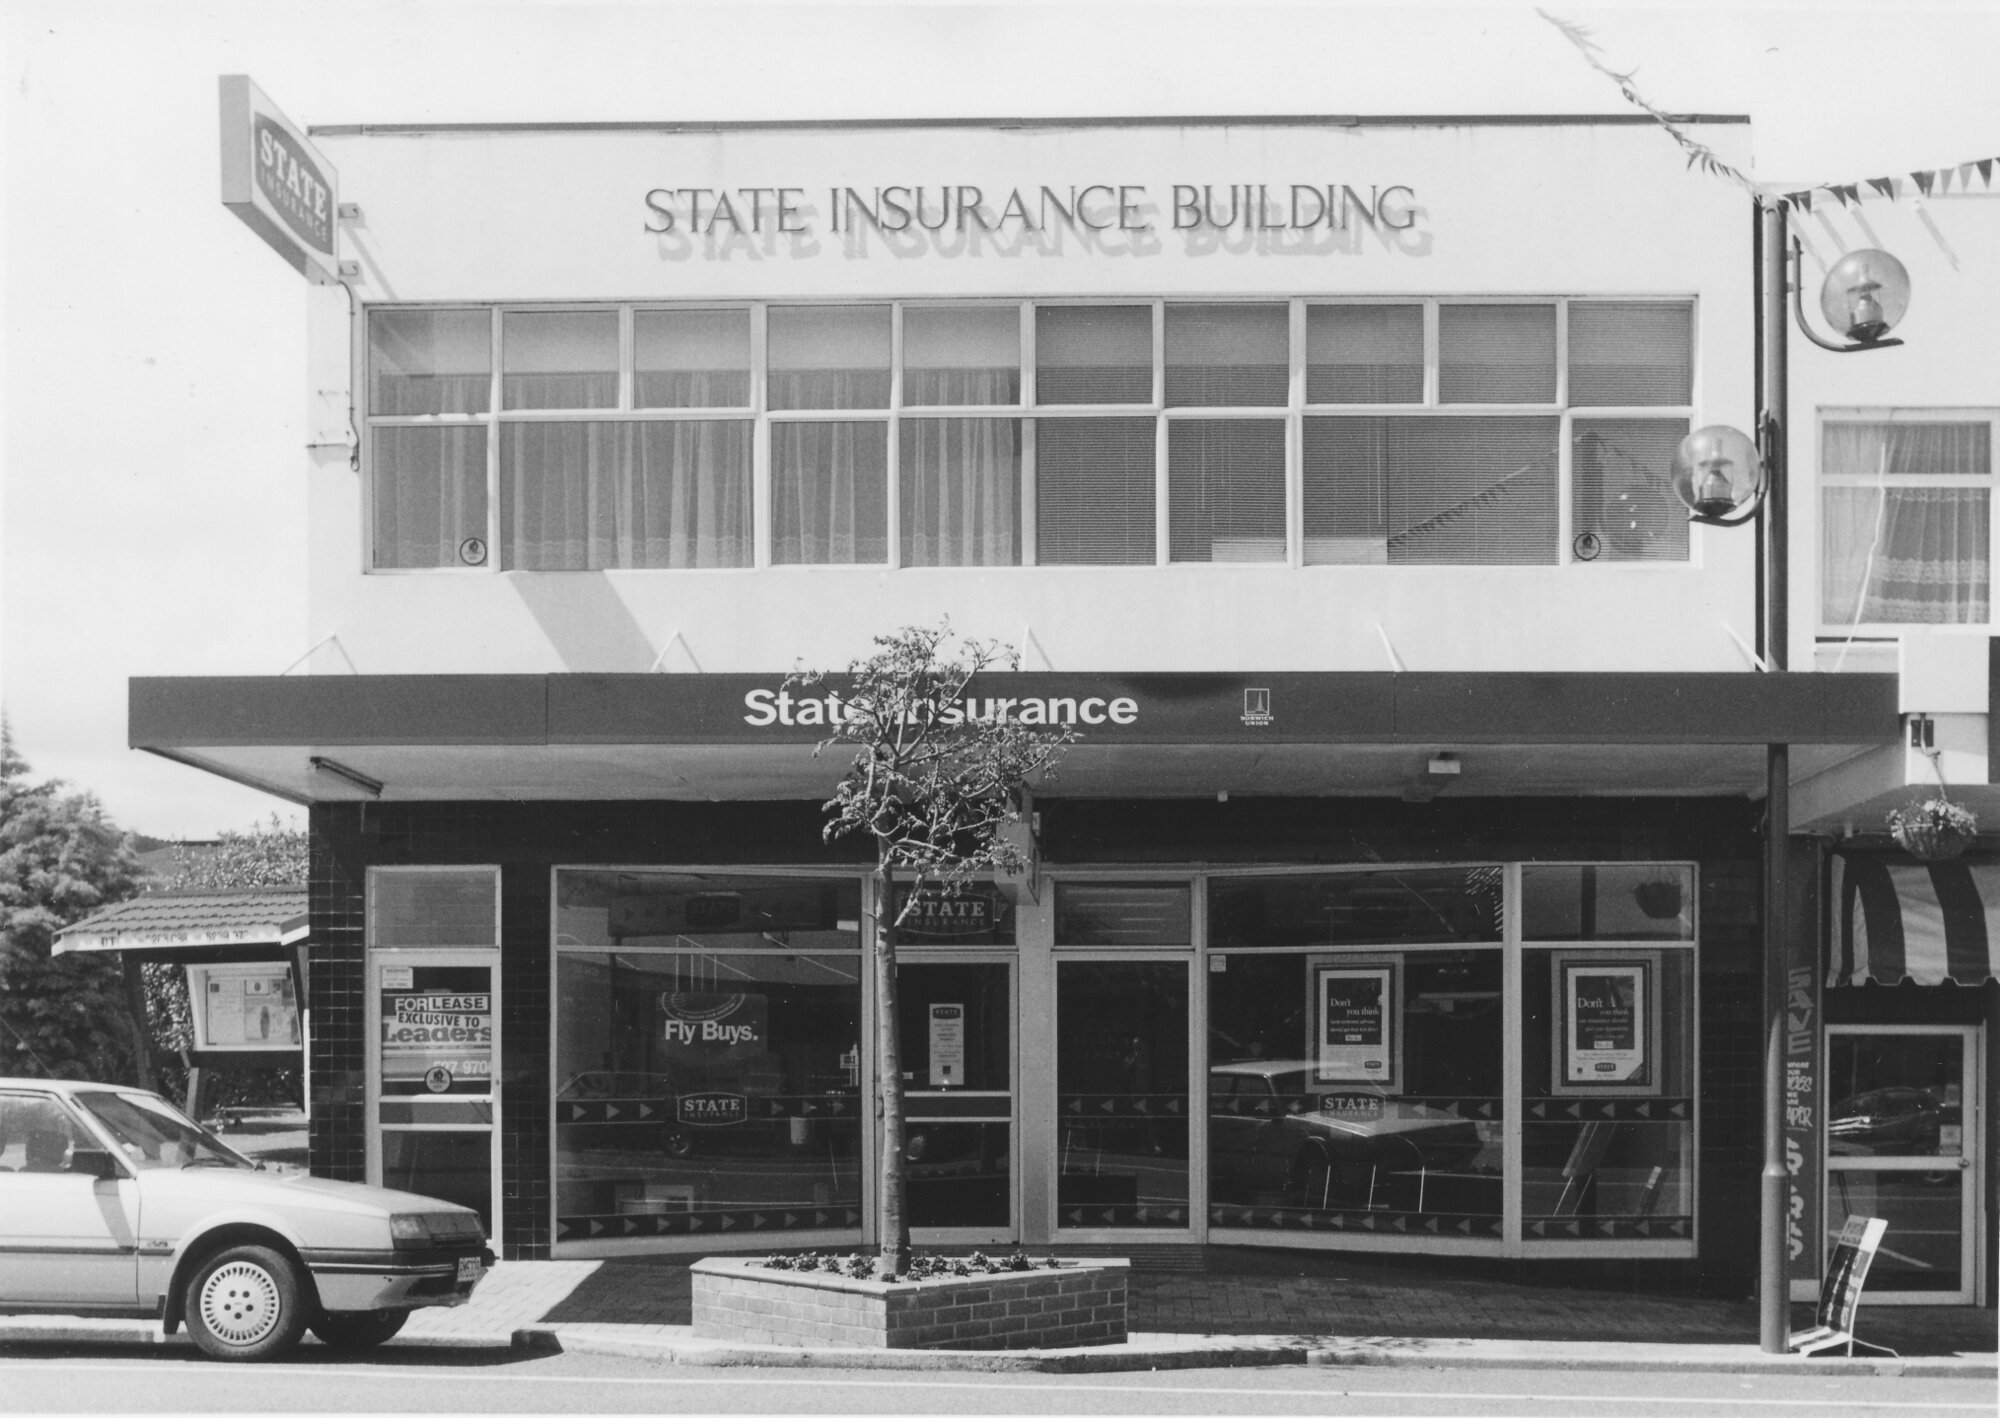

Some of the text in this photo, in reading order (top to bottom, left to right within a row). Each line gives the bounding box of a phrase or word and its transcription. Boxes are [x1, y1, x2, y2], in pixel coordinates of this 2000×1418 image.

[260, 128, 327, 222] STATE
[644, 184, 1416, 234] STATE INSURANCE BUILDING
[743, 687, 1139, 725] State Insurance
[907, 901, 985, 917] STATE
[395, 997, 484, 1011] FOR LEASE
[1330, 998, 1352, 1007] Don't
[1578, 997, 1603, 1008] Don't
[1346, 1006, 1380, 1017] you think
[398, 1012, 480, 1028] EXCLUSIVE TO
[382, 1022, 491, 1042] Leaders
[665, 1019, 758, 1045] Fly Buys.
[462, 1060, 491, 1075] 970
[684, 1098, 741, 1111] STATE
[1324, 1097, 1379, 1110] STATE
